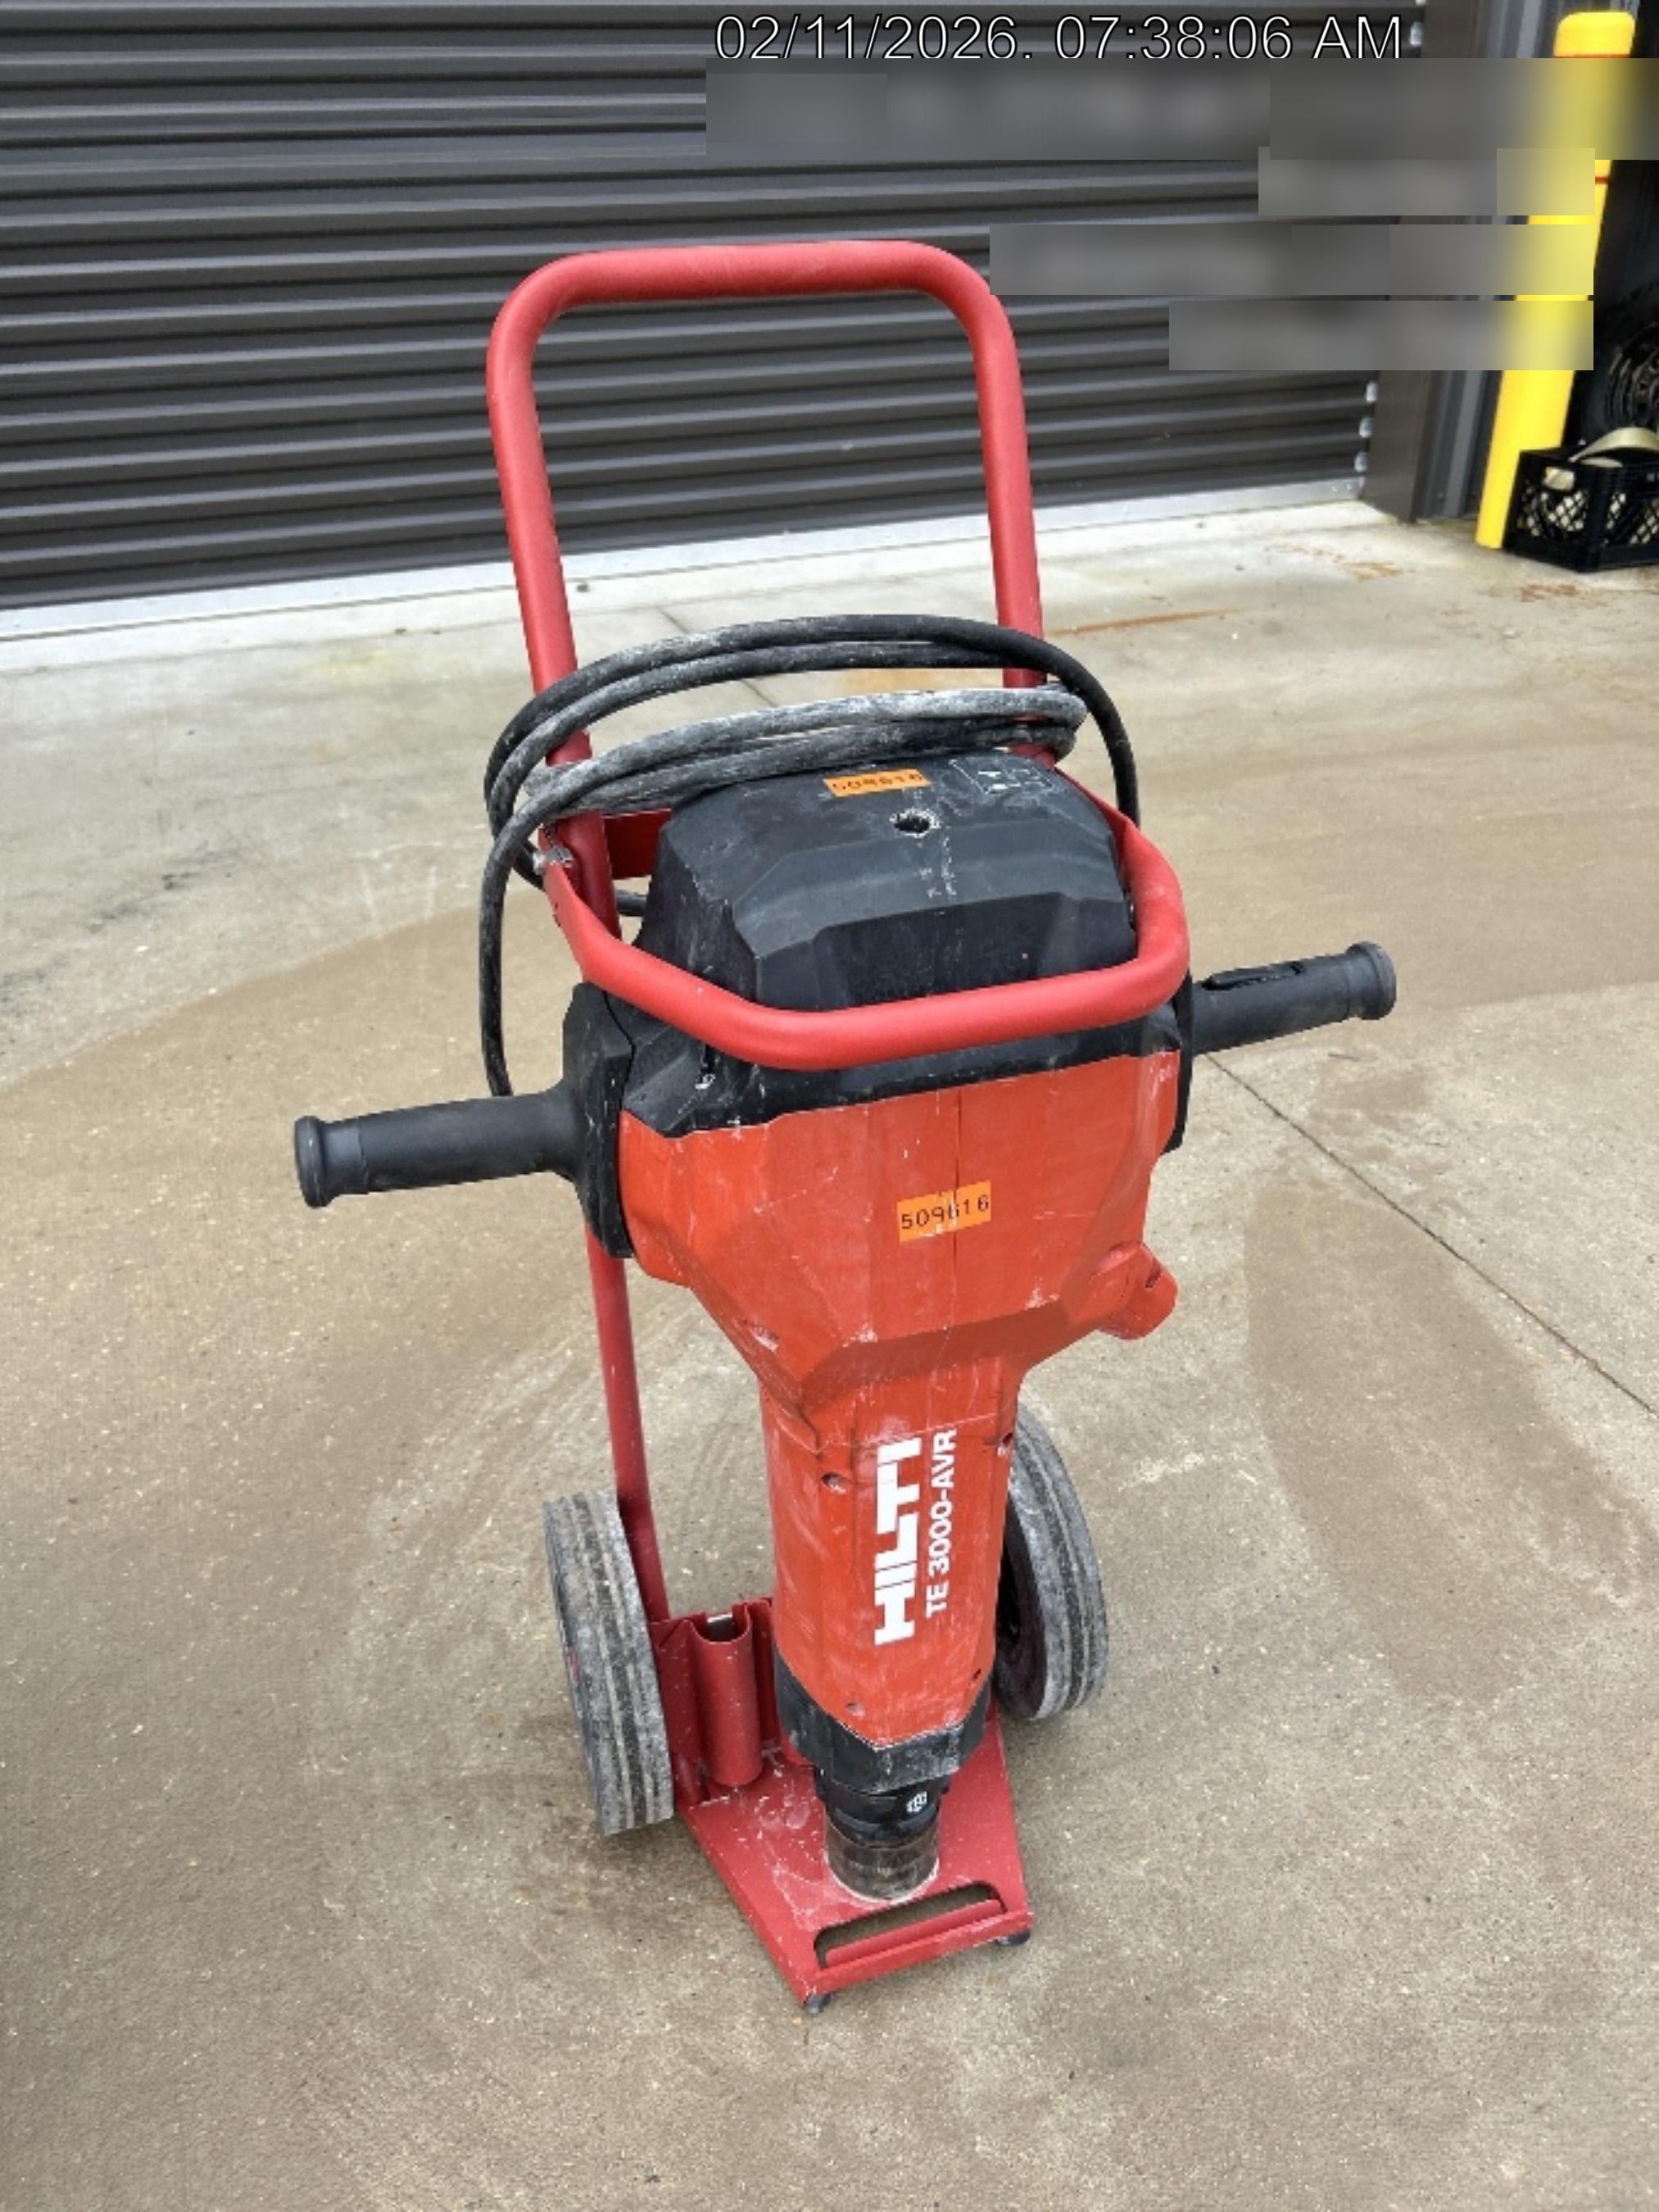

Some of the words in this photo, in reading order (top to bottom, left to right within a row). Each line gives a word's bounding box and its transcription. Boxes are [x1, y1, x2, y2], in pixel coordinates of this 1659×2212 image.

[901, 1194, 989, 1230] 509616
[873, 1437, 922, 1646] HILTI
[927, 1428, 958, 1578] 3000-AVR
[926, 1580, 950, 1619] TE
